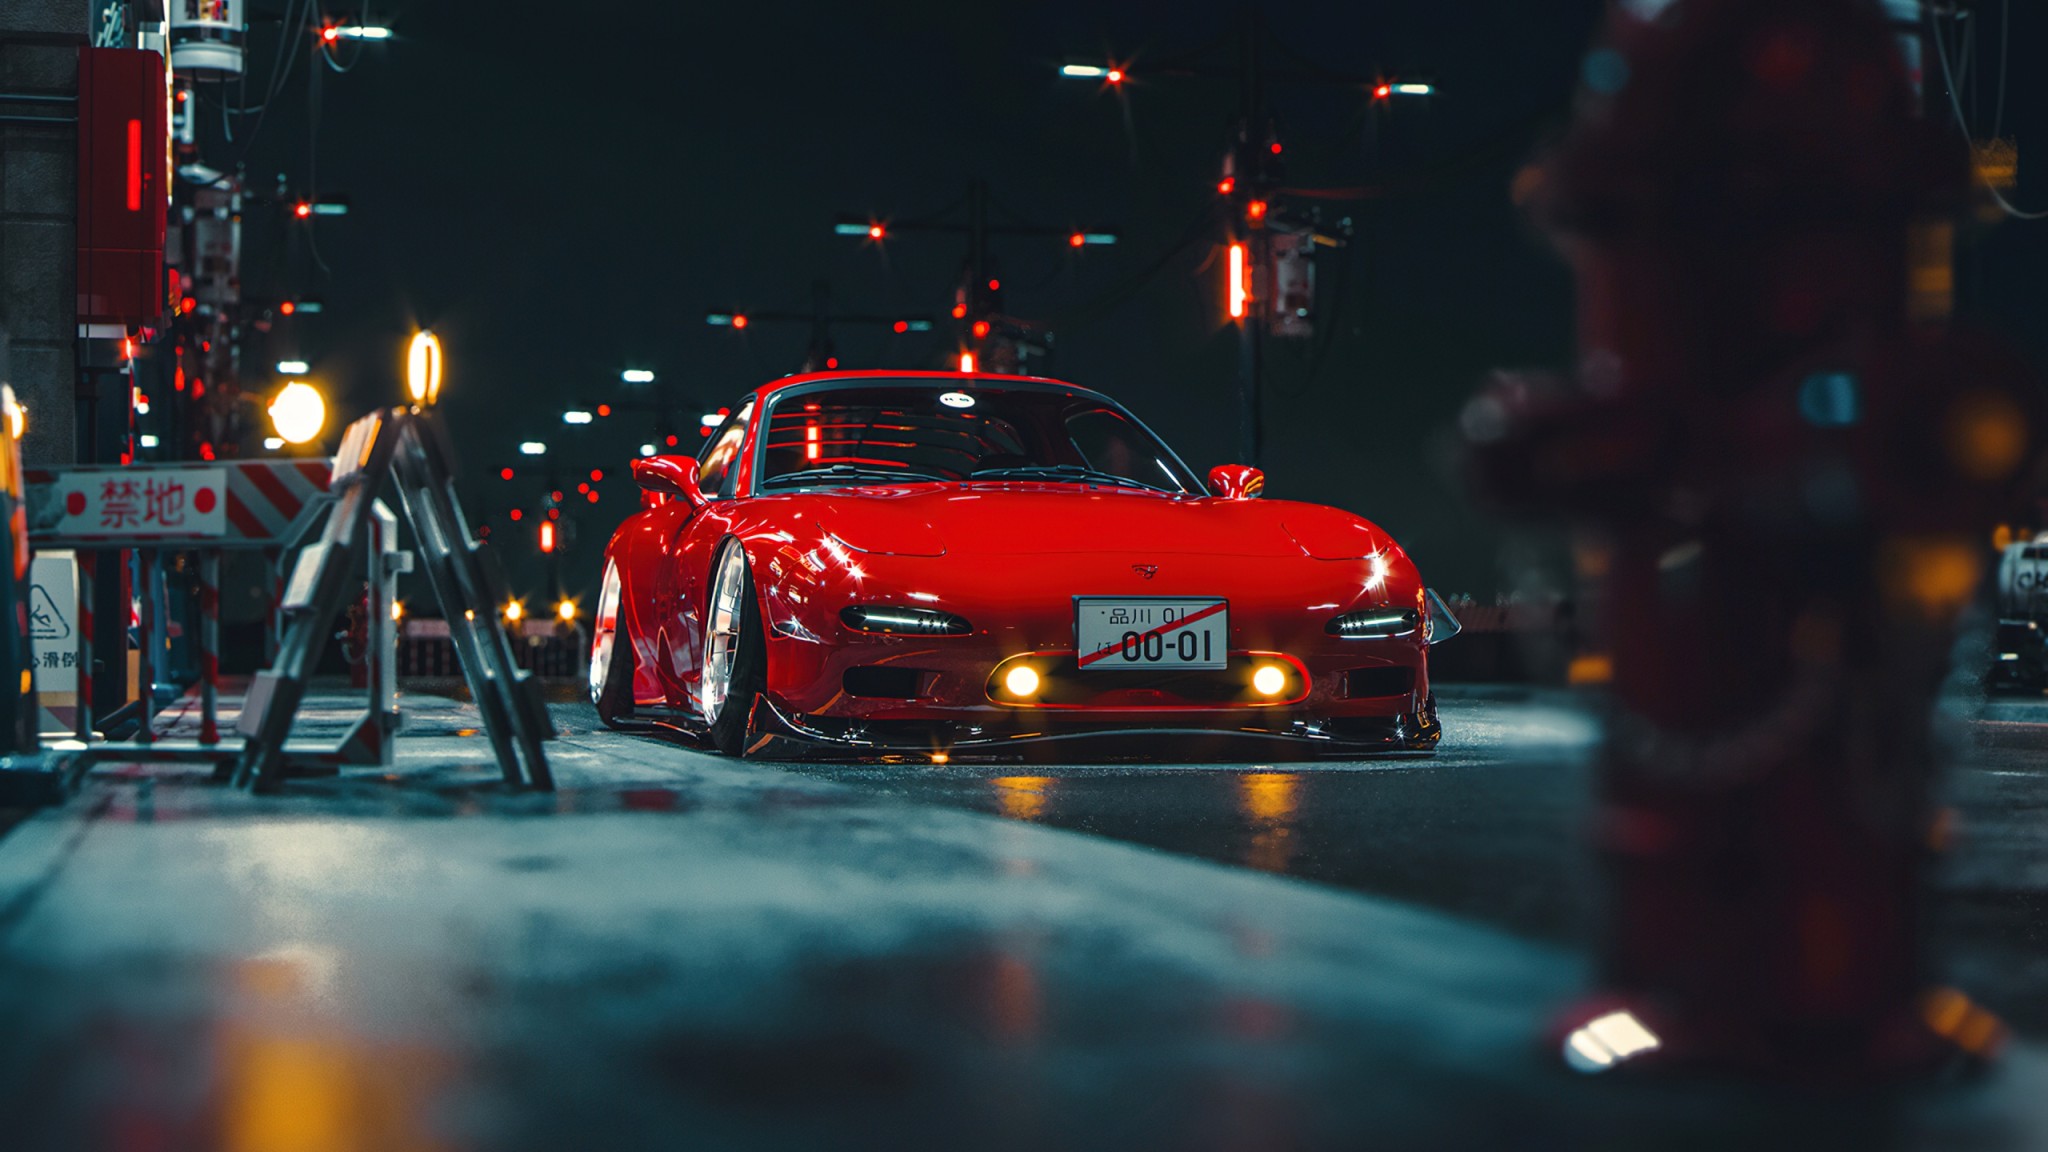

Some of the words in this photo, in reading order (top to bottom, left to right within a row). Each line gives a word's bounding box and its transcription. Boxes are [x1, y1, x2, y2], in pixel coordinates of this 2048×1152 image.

[99, 477, 185, 528] 禁地
[1109, 608, 1151, 624] 品川
[1121, 630, 1211, 662] 00-01
